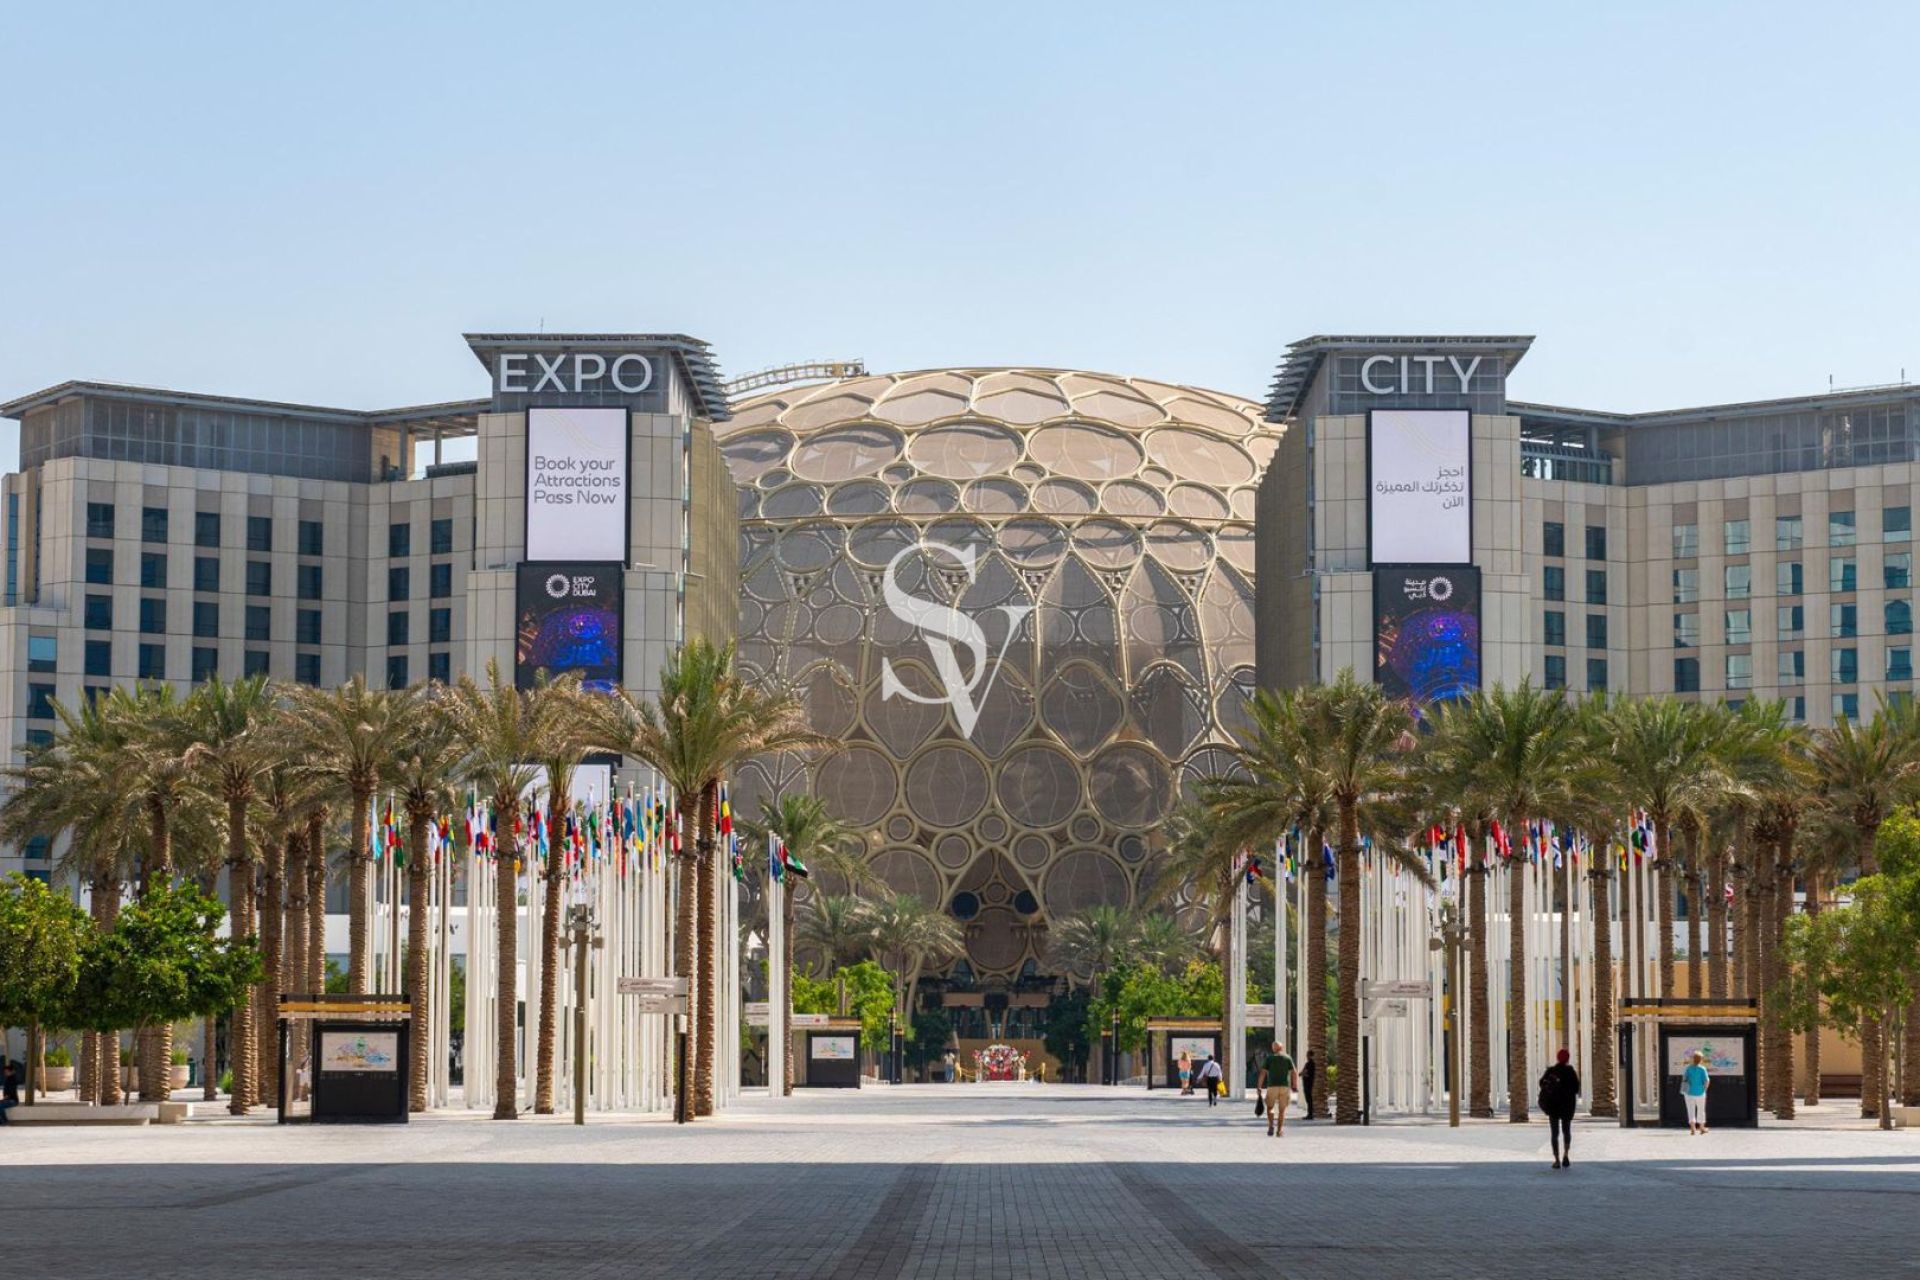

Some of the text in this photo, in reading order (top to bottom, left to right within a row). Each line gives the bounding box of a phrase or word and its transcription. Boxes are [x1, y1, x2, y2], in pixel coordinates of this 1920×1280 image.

[499, 353, 653, 394] EXPO
[1361, 354, 1483, 395] CITY
[534, 456, 615, 474] Book your
[534, 473, 621, 487] Attractions
[1437, 466, 1464, 480] احجز
[1376, 480, 1419, 495] المميزة
[534, 490, 617, 504] Pass Now
